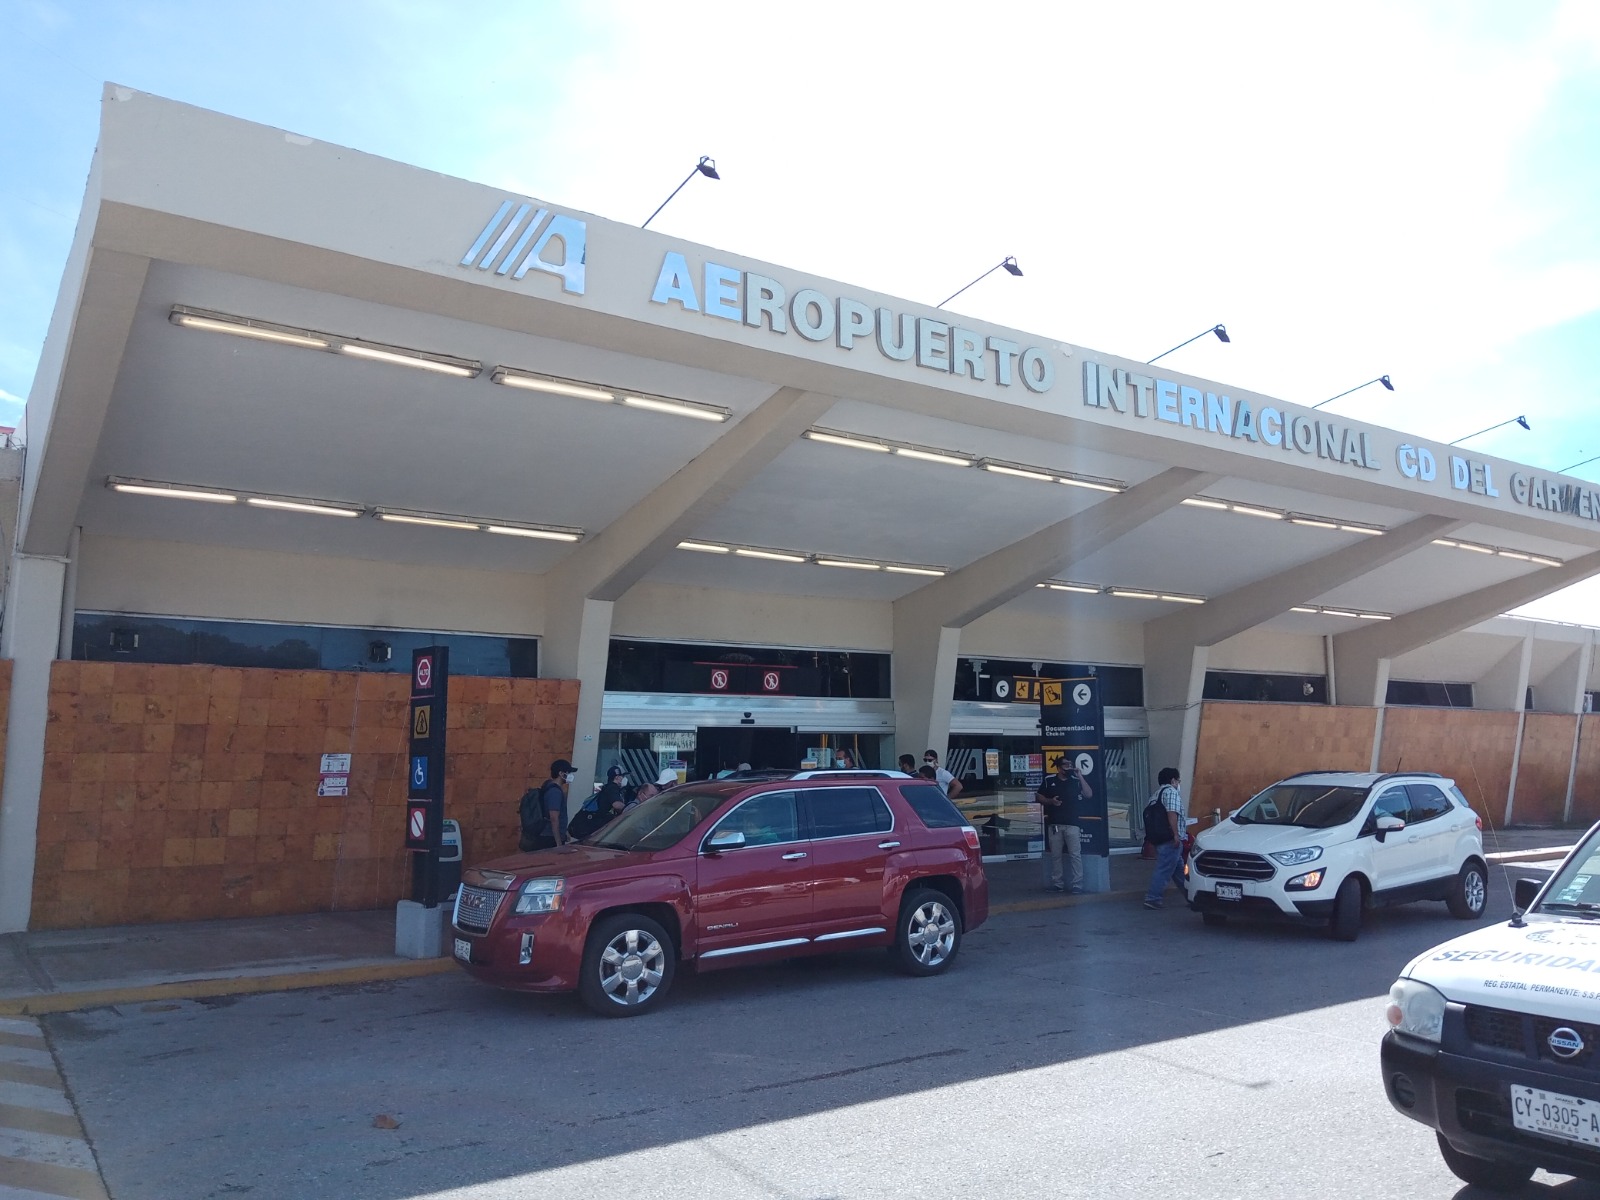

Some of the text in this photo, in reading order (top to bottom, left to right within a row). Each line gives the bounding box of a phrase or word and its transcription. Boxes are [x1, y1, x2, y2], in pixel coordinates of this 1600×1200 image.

[650, 250, 1056, 394] AEROPUERTO
[1082, 359, 1382, 471] INTERNACIONAL
[1396, 442, 1437, 482] CD
[1449, 454, 1500, 499] DEL
[419, 668, 429, 676] ALTO
[706, 922, 739, 931] DENALI
[1432, 949, 1600, 973] SEGURIDA
[1484, 979, 1498, 988] REG.
[1500, 980, 1527, 991] ESTATAL
[1530, 984, 1581, 997] PERMANENTE:
[1547, 1037, 1580, 1049] NISSAN
[1515, 1096, 1600, 1133] CY-0305-A
[1536, 1119, 1580, 1134] CHIAPAS
